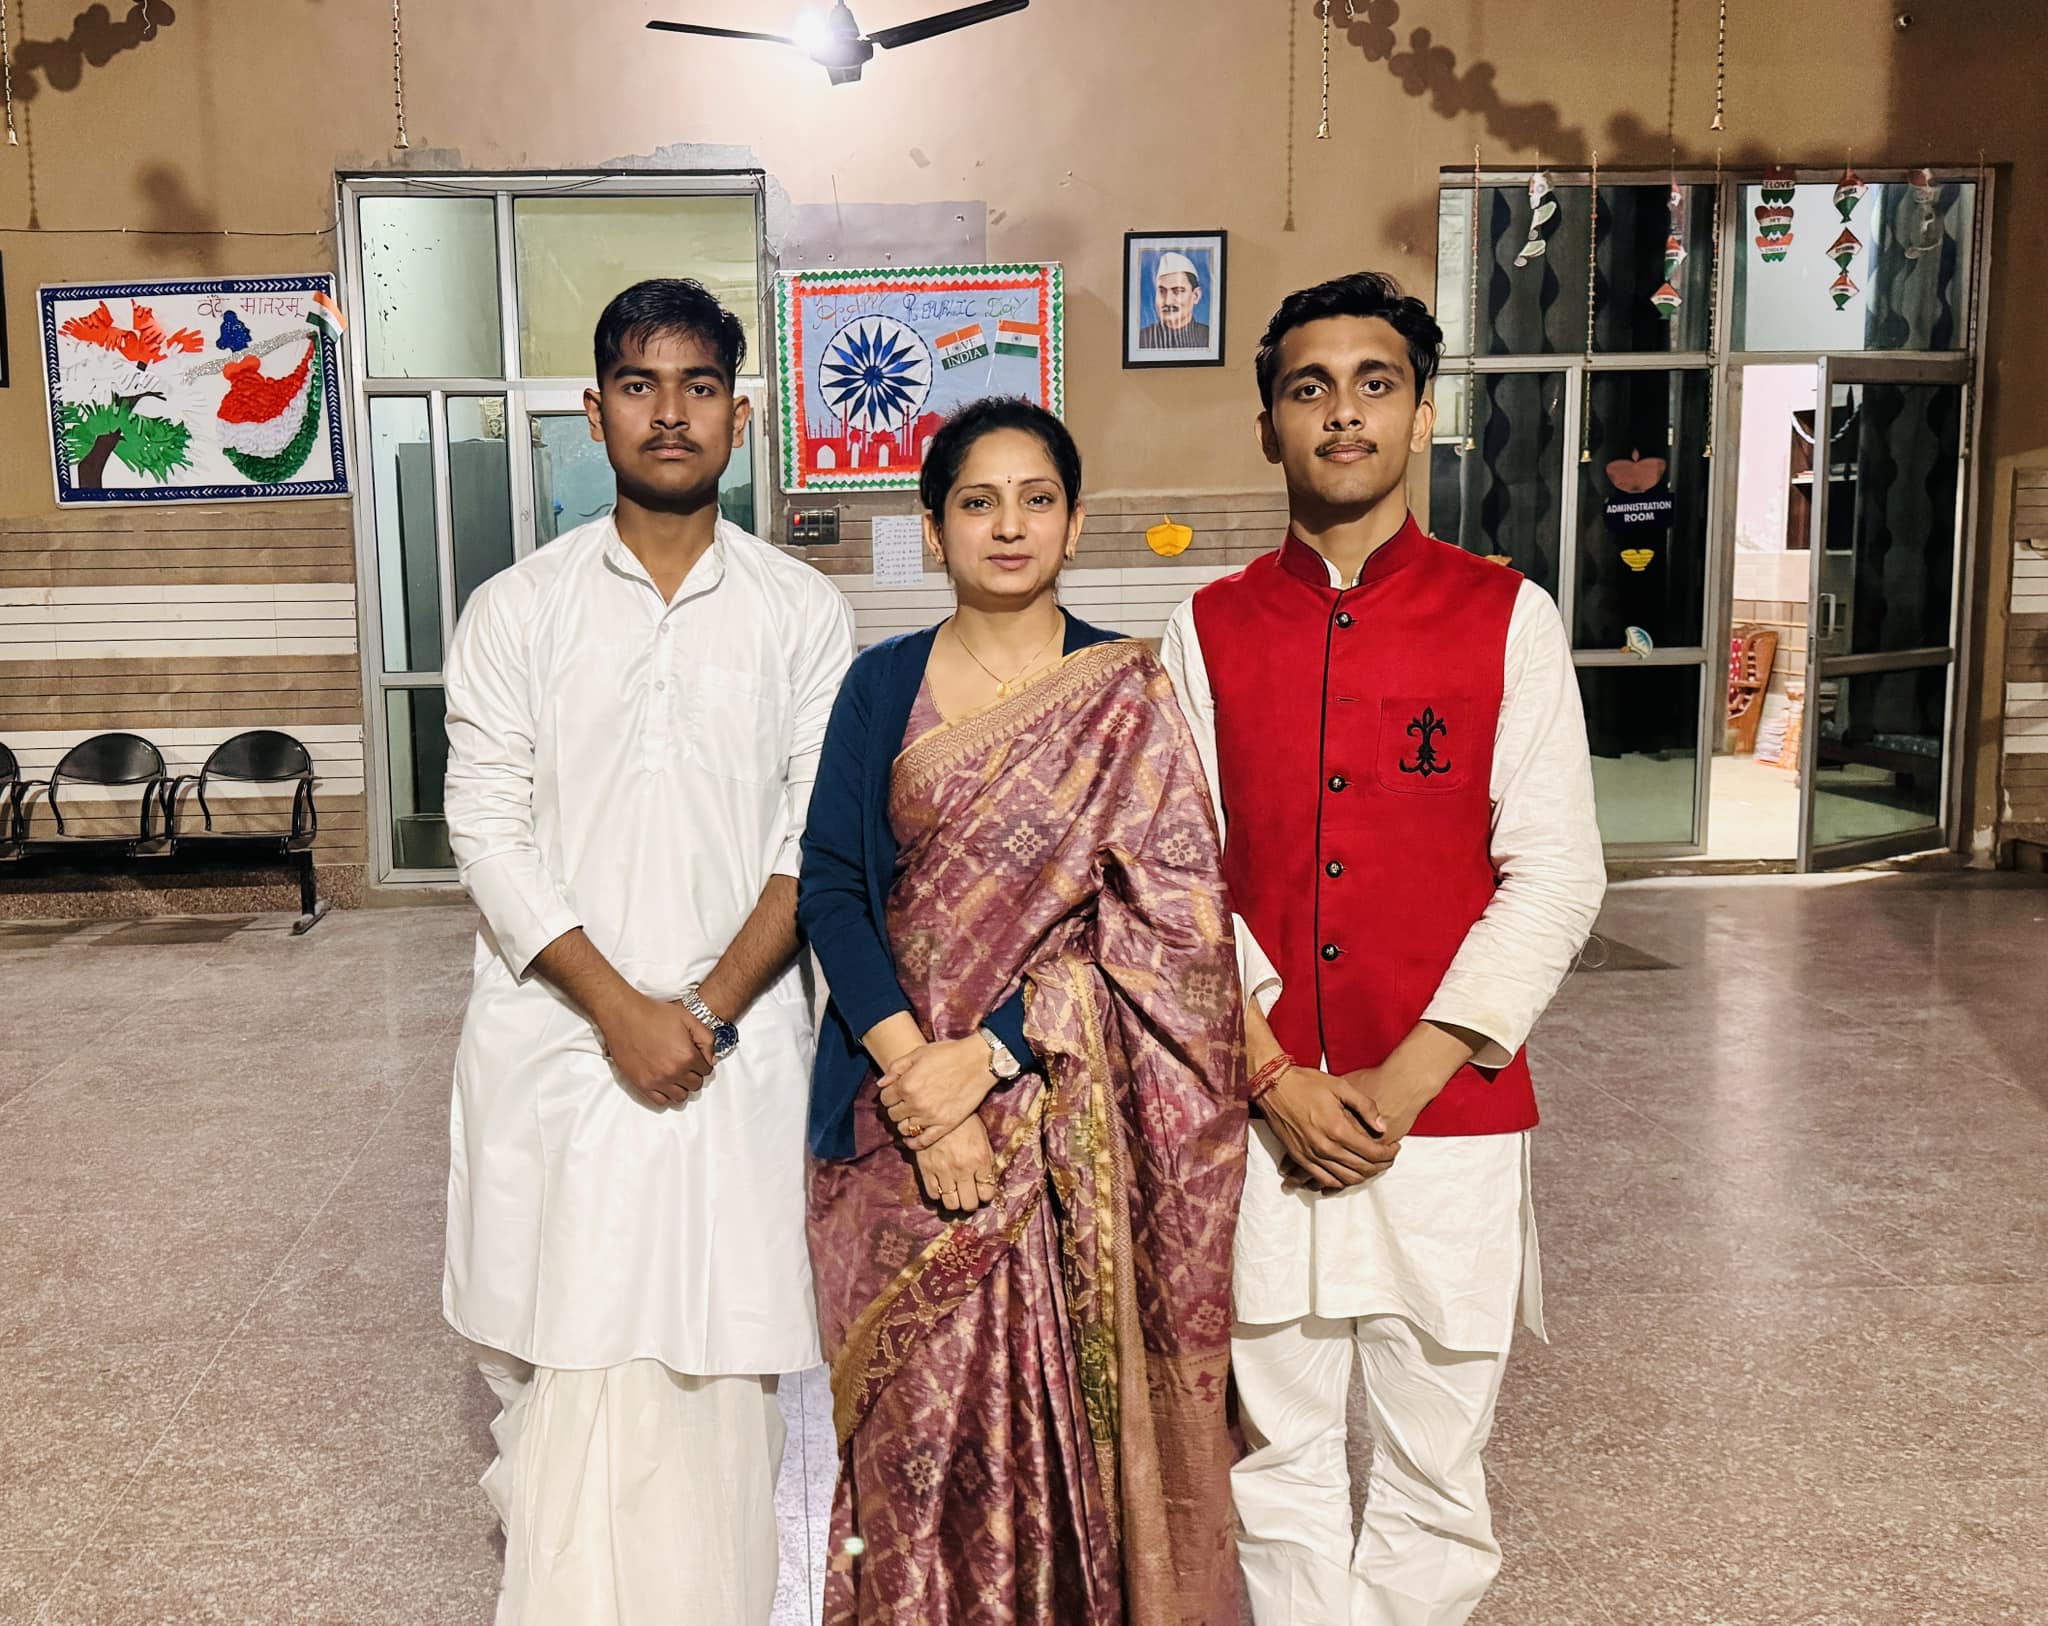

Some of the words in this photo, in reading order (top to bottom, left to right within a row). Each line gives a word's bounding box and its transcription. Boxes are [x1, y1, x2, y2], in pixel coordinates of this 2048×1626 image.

[1769, 181, 1791, 189] LOVE
[946, 348, 982, 368] INDIA
[1606, 501, 1672, 514] ADMINISTRATION
[1624, 512, 1654, 523] ROOM
